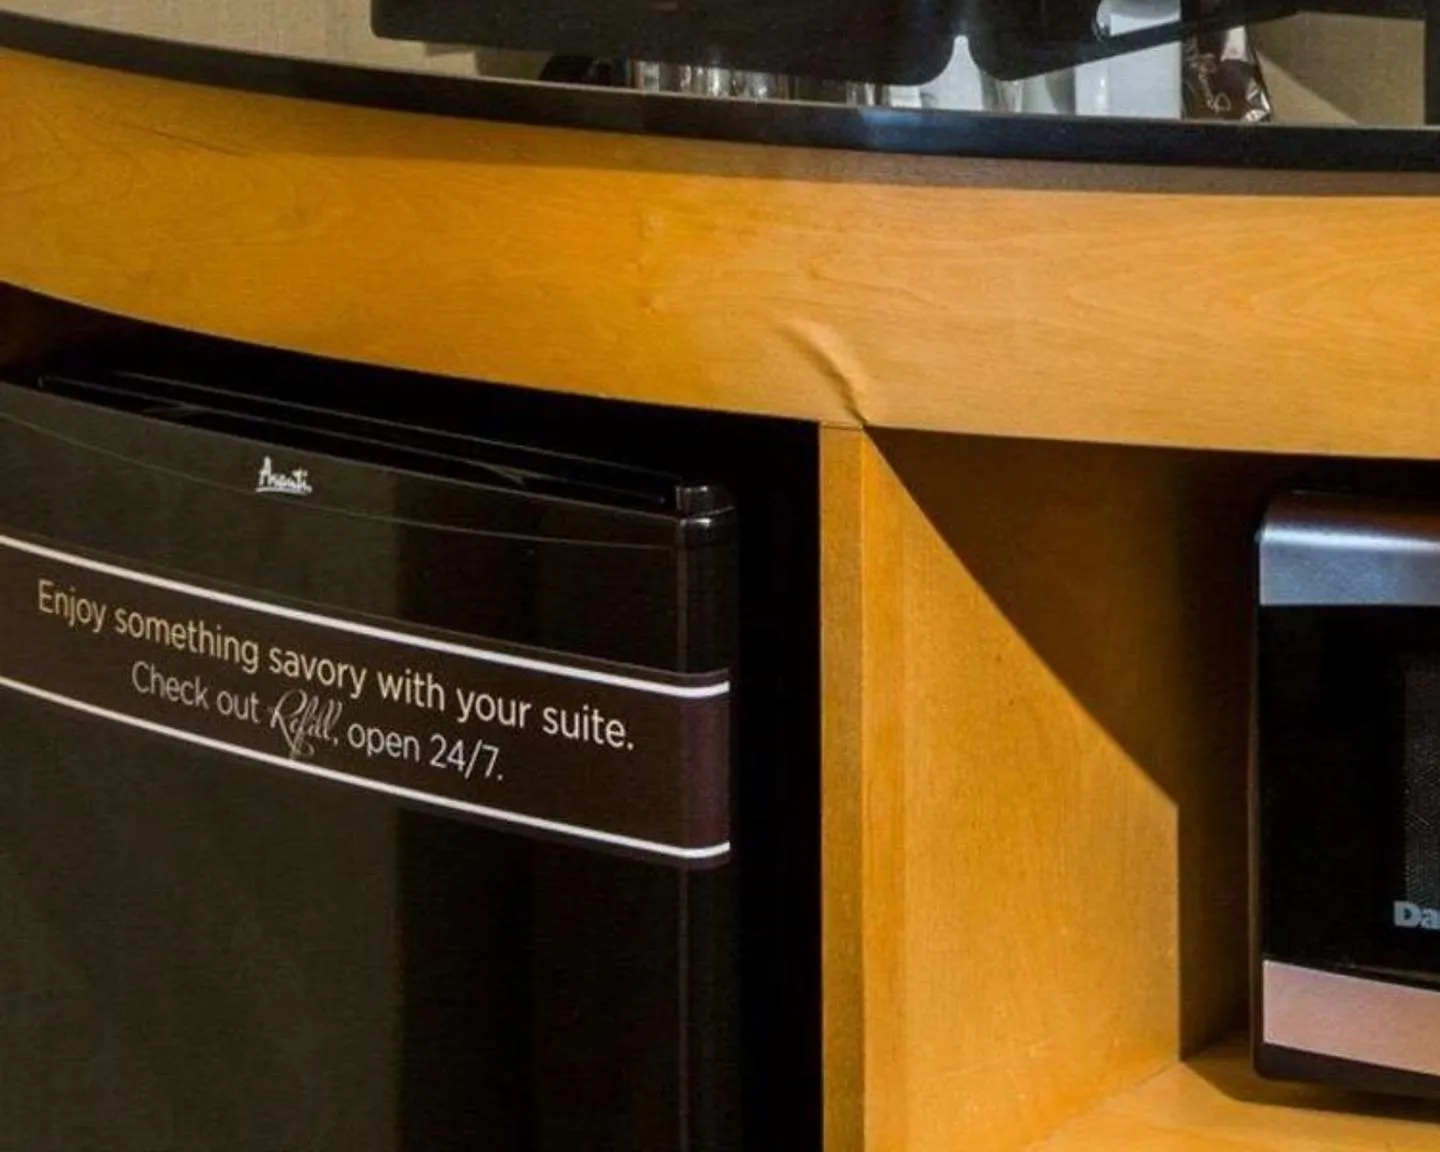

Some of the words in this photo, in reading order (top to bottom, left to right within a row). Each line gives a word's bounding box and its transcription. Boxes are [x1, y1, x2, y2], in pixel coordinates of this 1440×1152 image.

[37, 579, 106, 633] Enjoy
[114, 607, 259, 674] something
[268, 647, 367, 699] savory
[377, 668, 445, 712] with
[455, 688, 532, 728] your
[542, 704, 635, 751] suite.
[131, 659, 209, 710] Check
[216, 690, 261, 724] out
[347, 722, 420, 762] open
[429, 733, 504, 781] 24/7.
